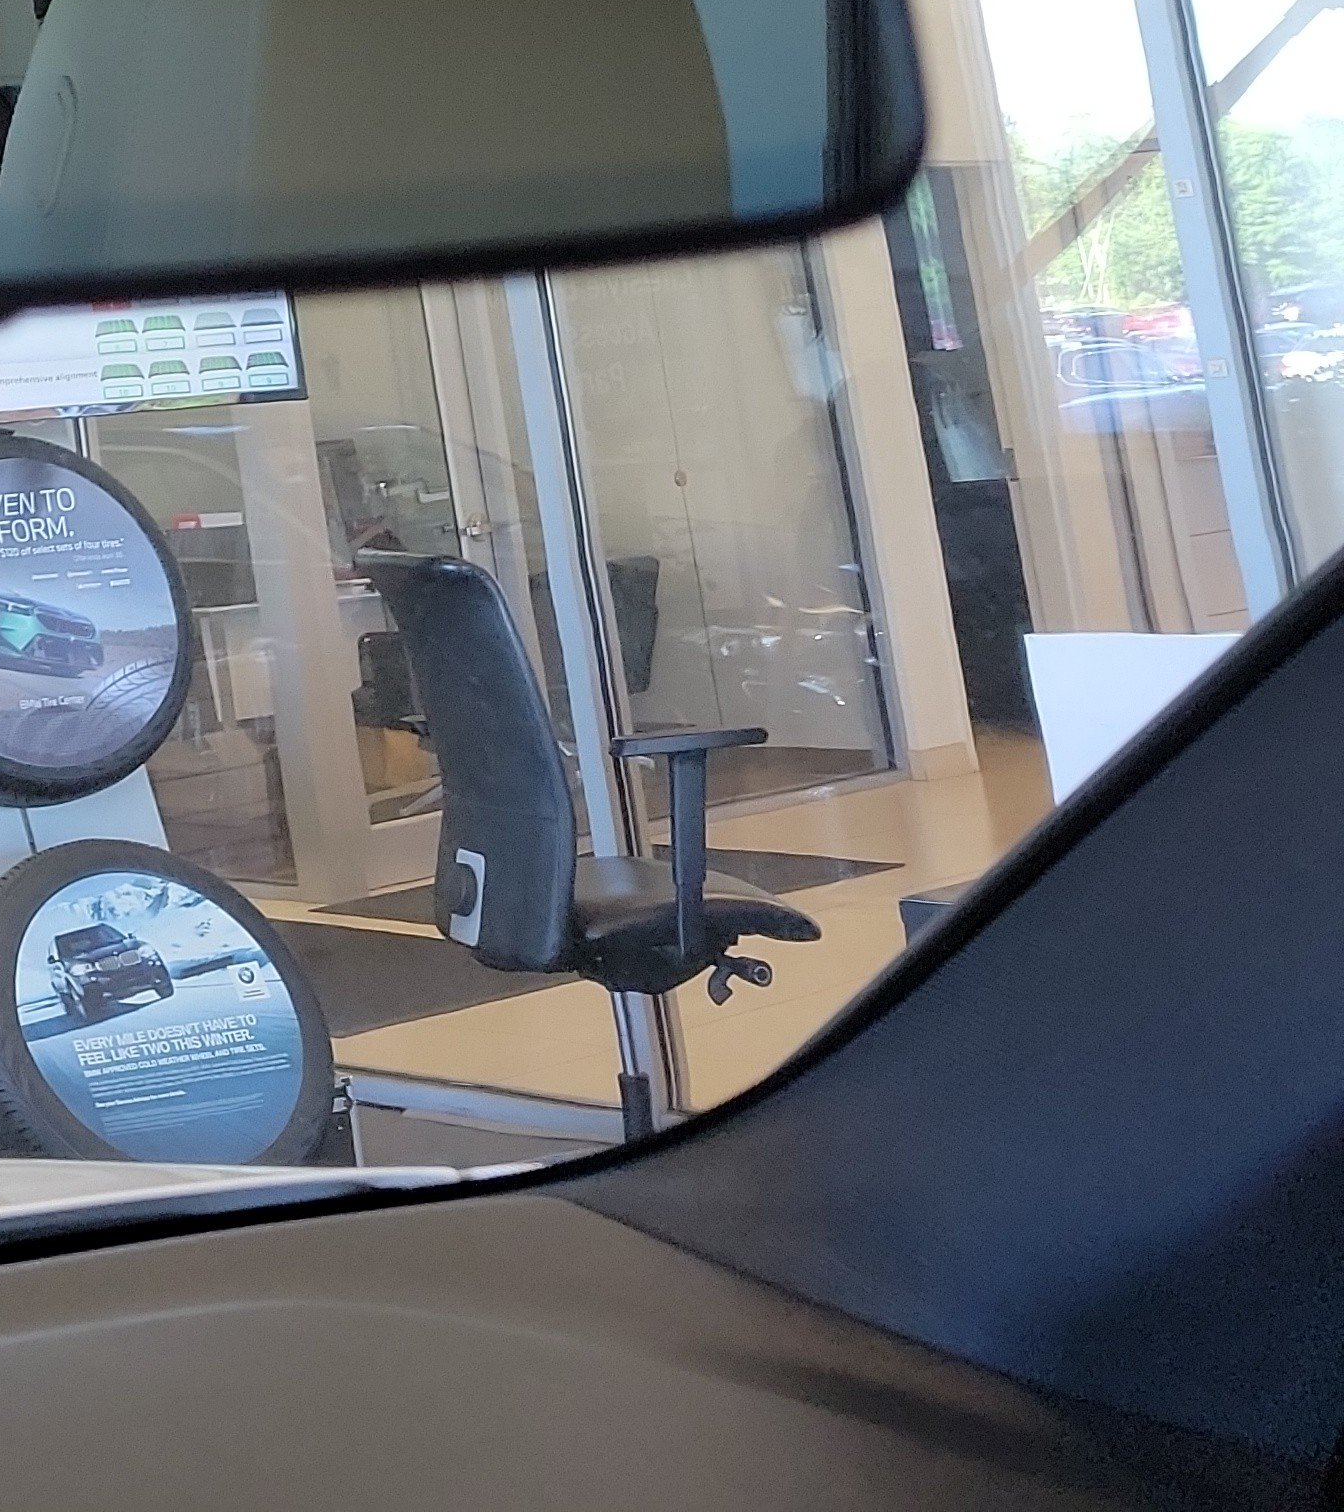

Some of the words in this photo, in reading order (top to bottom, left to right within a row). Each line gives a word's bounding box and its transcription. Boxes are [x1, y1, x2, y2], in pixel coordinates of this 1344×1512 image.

[55, 370, 98, 382] alignment
[40, 487, 76, 512] TO
[20, 546, 30, 556] off
[32, 544, 55, 554] select
[56, 543, 73, 552] sets
[75, 542, 82, 550] of
[84, 540, 101, 549] four
[75, 1036, 114, 1052] EVERY
[117, 1031, 146, 1046] MILE
[148, 1022, 201, 1041] DOESN'T
[203, 1017, 237, 1031] HAVE
[237, 1013, 257, 1027] TO
[79, 1051, 112, 1066] FEEL
[112, 1046, 140, 1061] LIKE
[140, 1042, 170, 1056] TWO
[172, 1036, 201, 1052] THIS
[202, 1028, 254, 1046] WINTER.
[102, 1063, 138, 1074] APPROVED
[138, 1060, 157, 1069] COLD
[157, 1056, 190, 1066] WEATHER
[215, 1048, 229, 1057] AND
